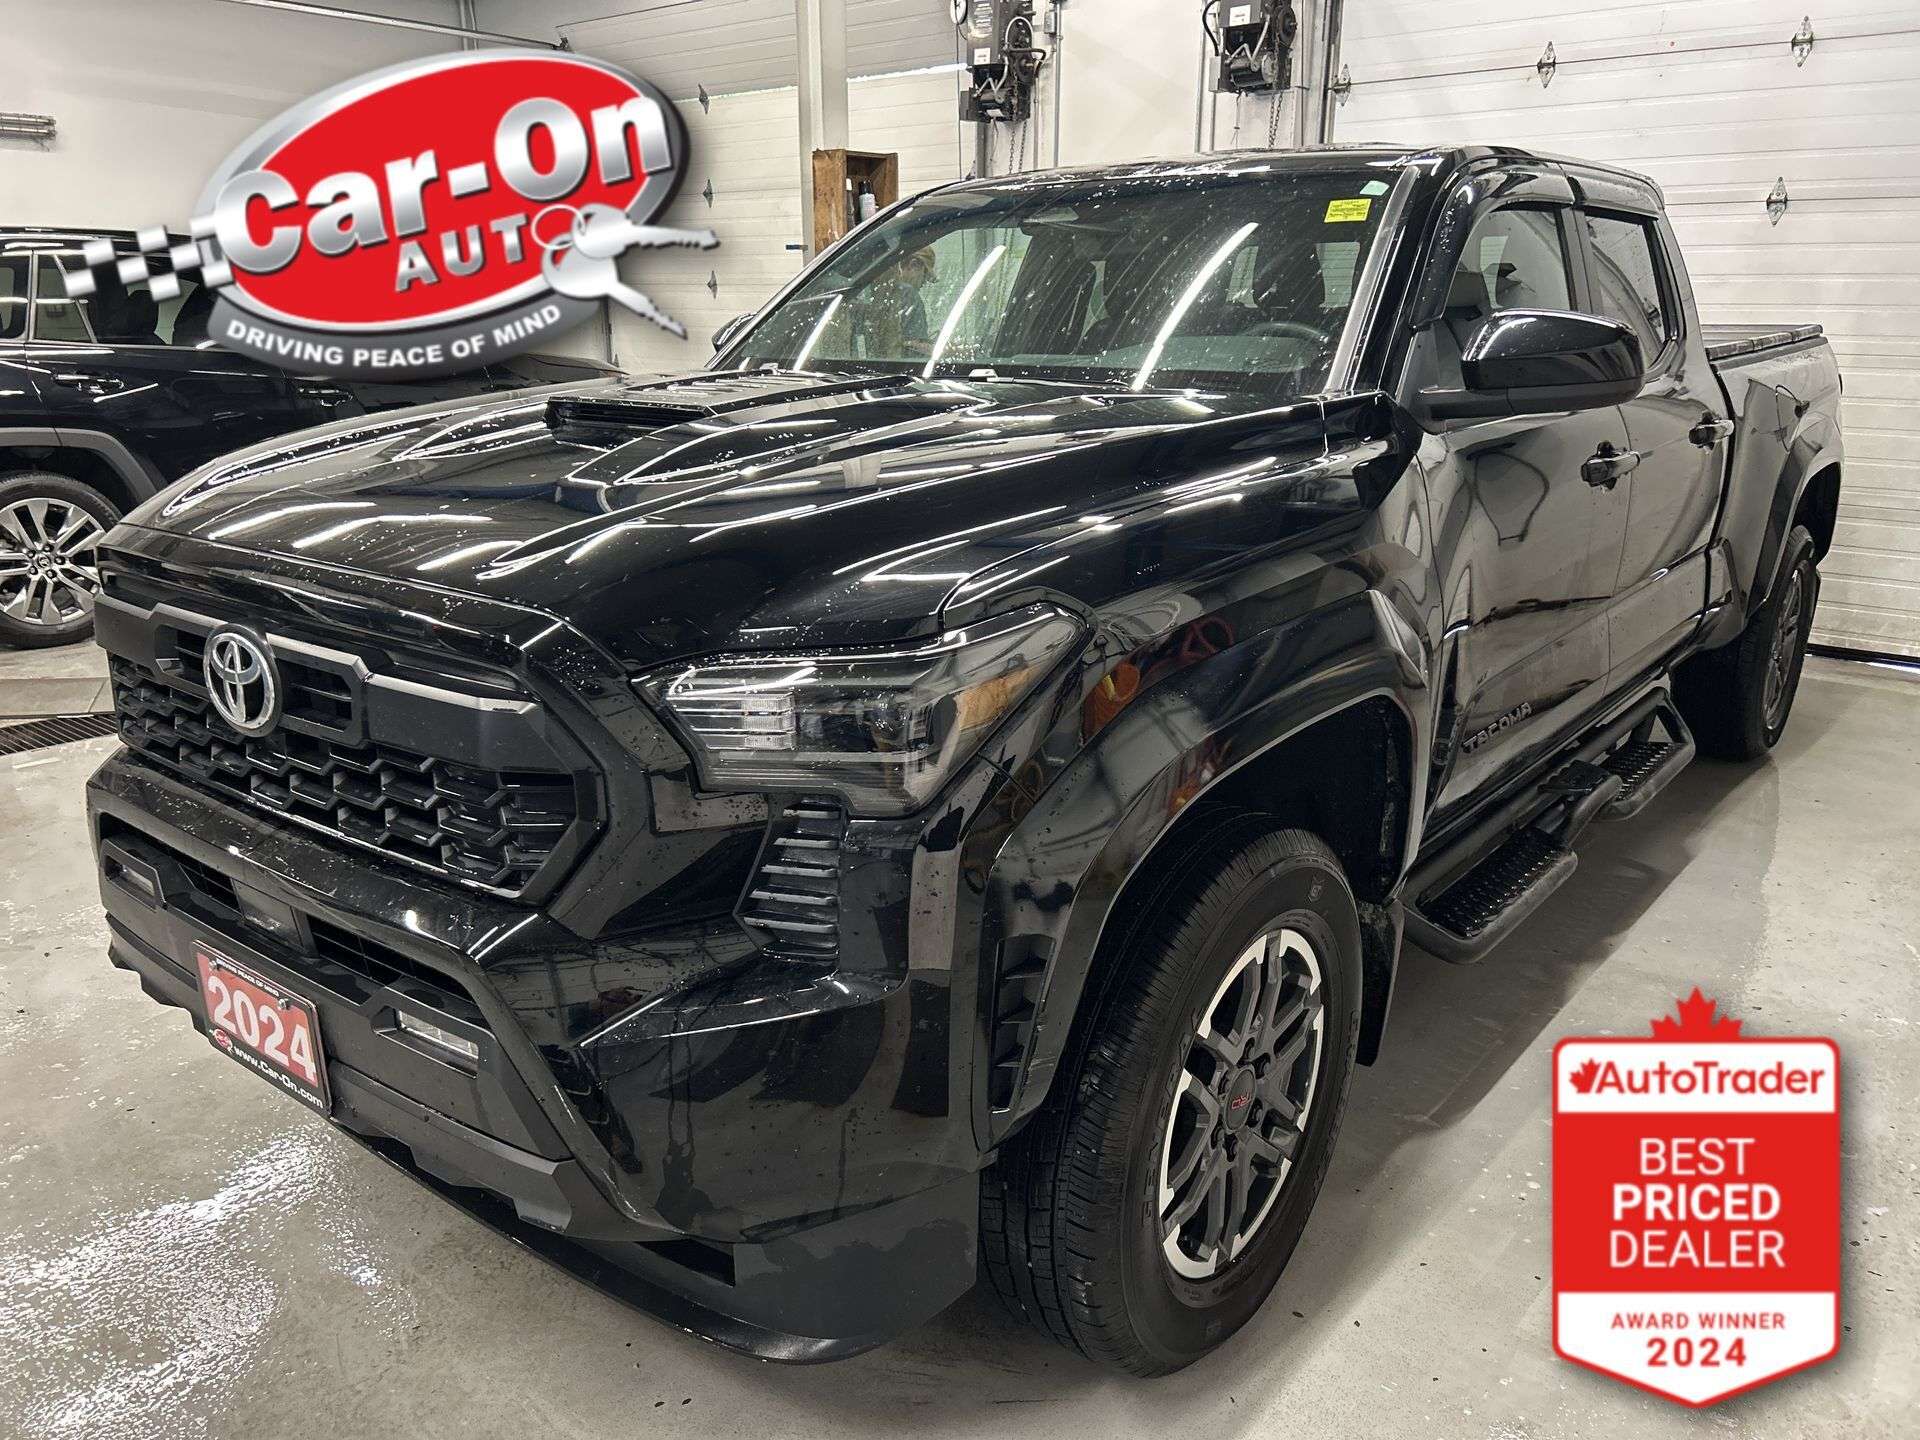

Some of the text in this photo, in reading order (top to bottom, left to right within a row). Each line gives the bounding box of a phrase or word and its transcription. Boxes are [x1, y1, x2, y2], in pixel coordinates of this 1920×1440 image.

[1462, 702, 1532, 750] TACOMA
[207, 975, 317, 1082] 2024
[233, 1046, 324, 1109] www.Car-On.com
